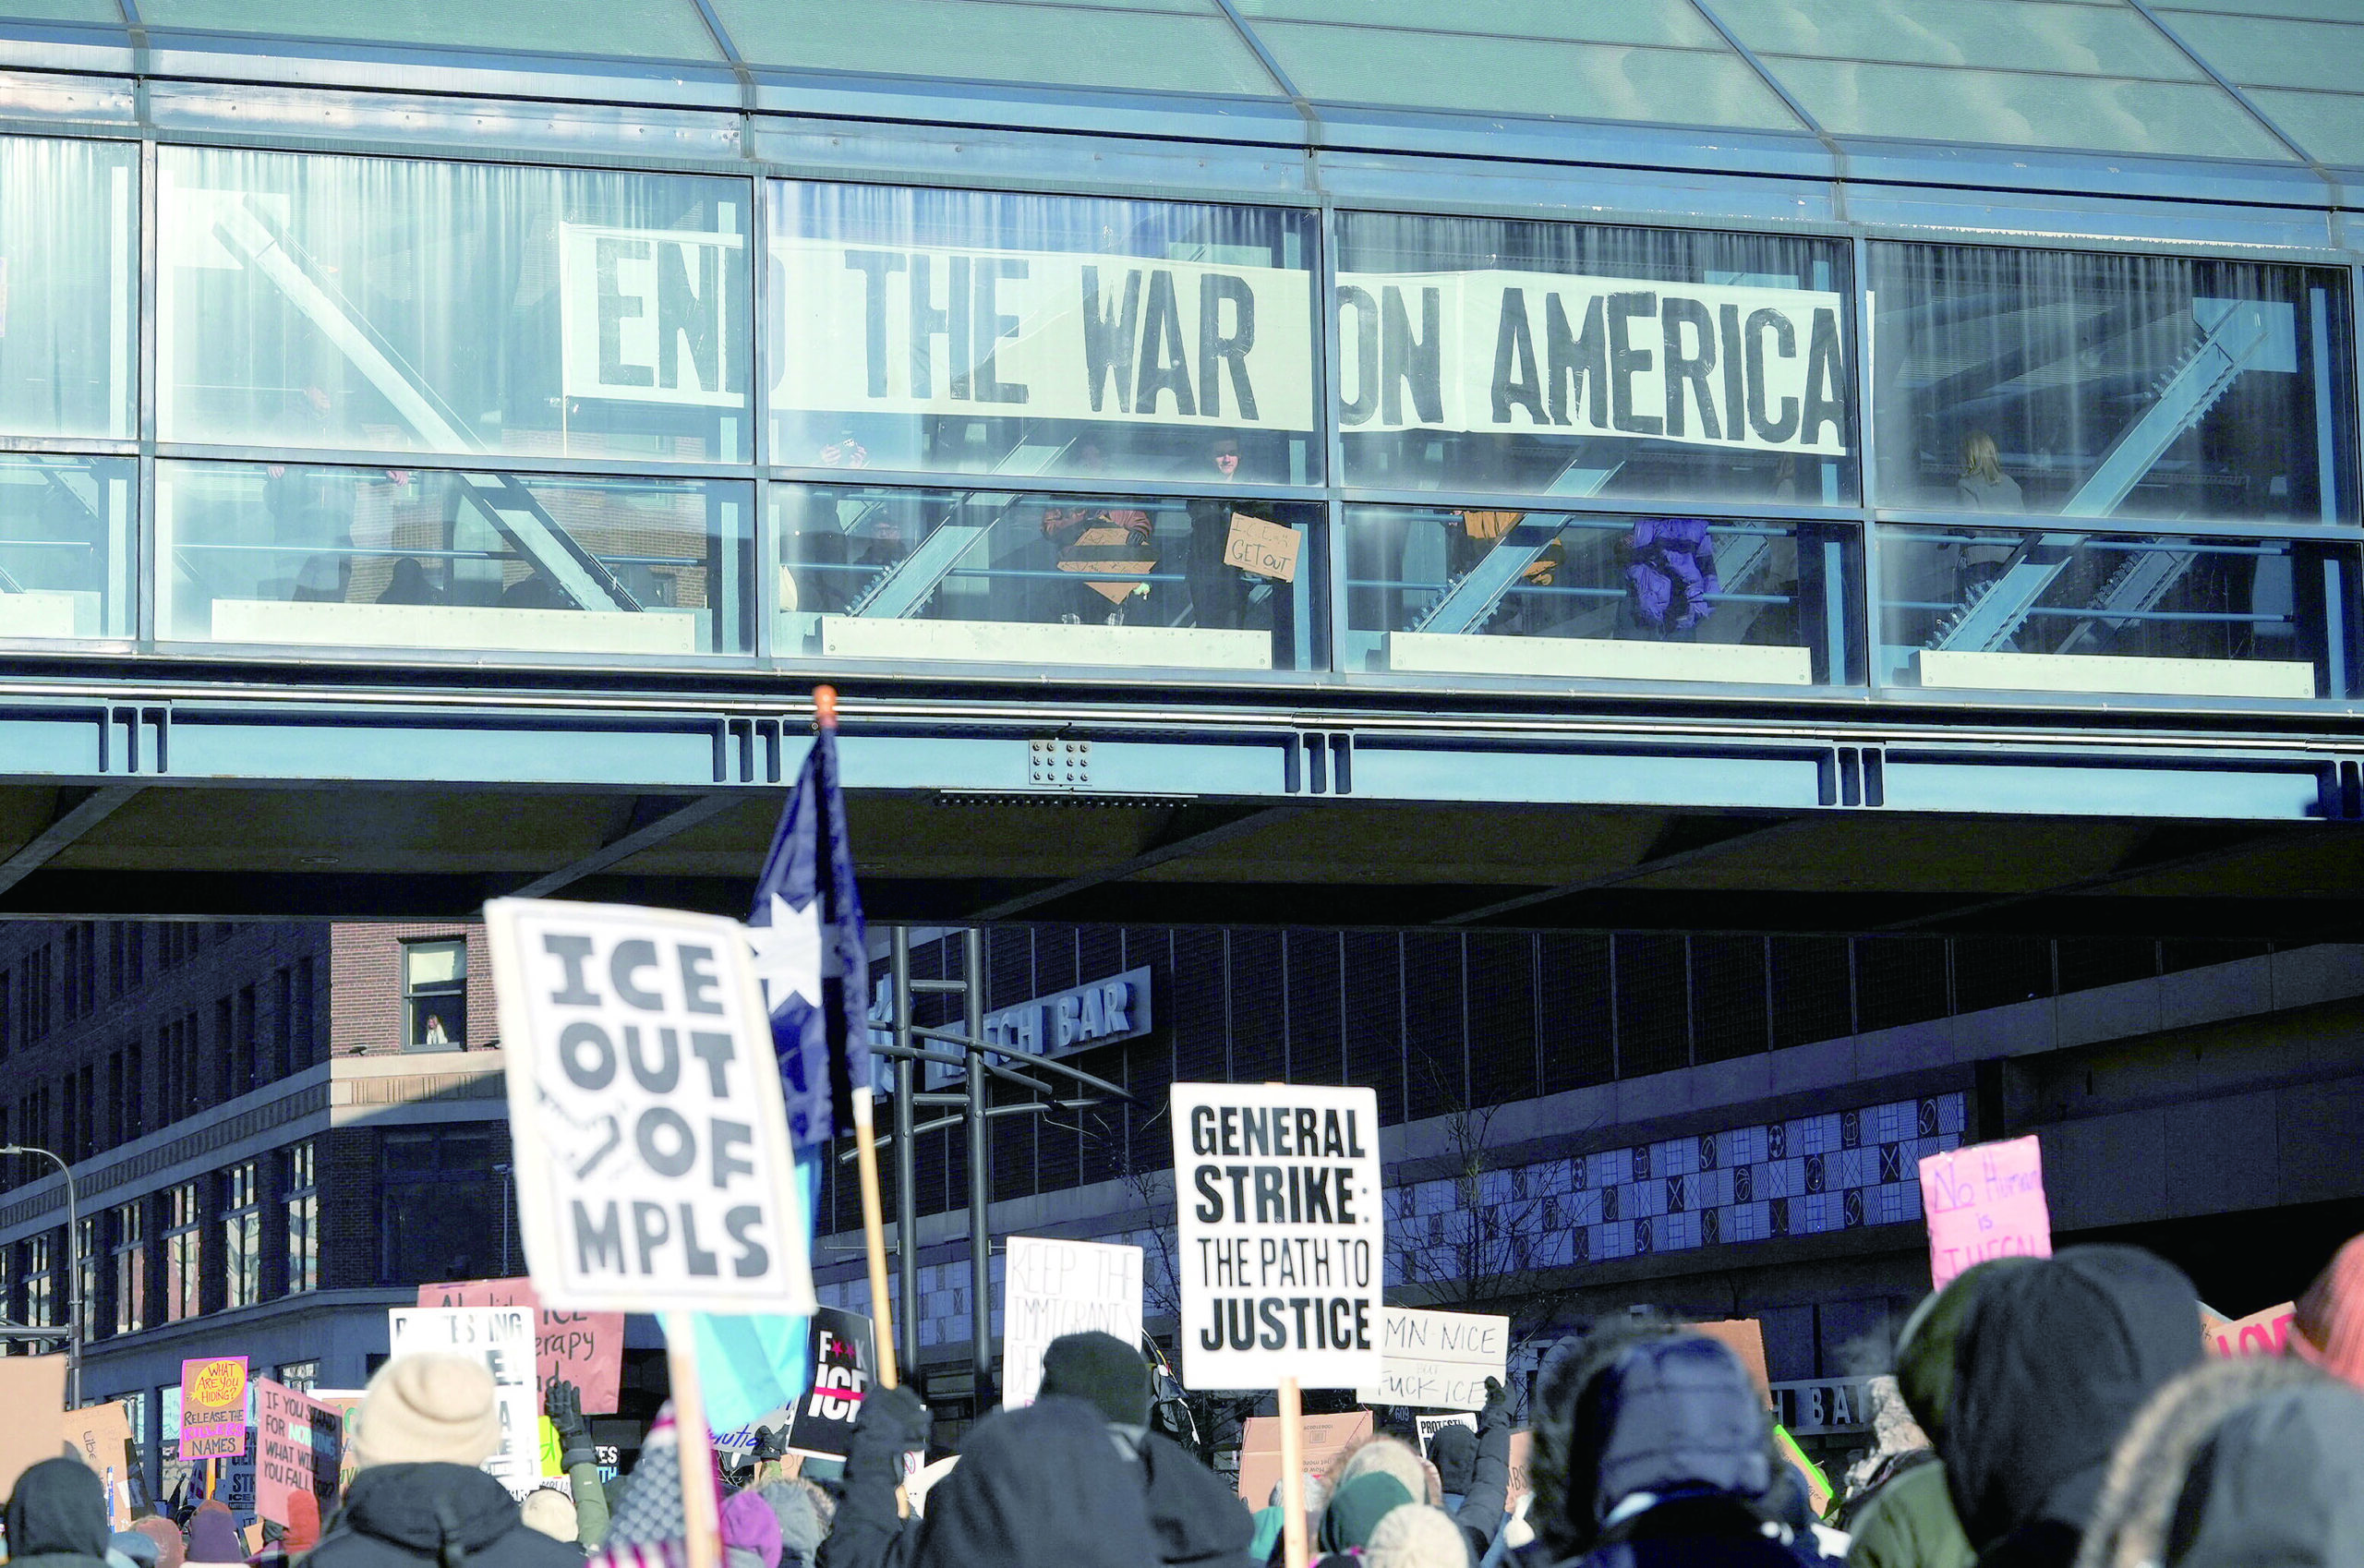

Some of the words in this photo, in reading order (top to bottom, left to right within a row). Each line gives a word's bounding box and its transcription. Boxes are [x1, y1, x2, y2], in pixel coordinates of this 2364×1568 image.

[597, 238, 785, 392] END
[845, 249, 1029, 404] THE
[1081, 265, 1260, 421] WAR
[1337, 285, 1444, 427] ON
[1491, 287, 1846, 445] AMERICA
[1232, 539, 1268, 566] GET
[1263, 554, 1291, 573] OUT
[541, 934, 724, 1015] ICE
[1057, 982, 1132, 1047] BAR
[560, 1022, 736, 1098] OUT
[636, 1106, 754, 1189] OF
[1191, 1105, 1366, 1159] GENERAL
[1195, 1164, 1371, 1224] STRIKE:
[1934, 1161, 1974, 1211] No
[572, 1200, 770, 1279] MPLS
[1976, 1212, 1993, 1231] is
[1011, 1244, 1076, 1295] KEEP
[1094, 1249, 1137, 1300] THE
[1198, 1238, 1249, 1287] THE
[1261, 1238, 1330, 1287] PATH
[1343, 1239, 1369, 1287] TO
[1201, 1297, 1371, 1351] JUSTICE
[1385, 1316, 1428, 1348] MN
[1441, 1322, 1495, 1353] NICE
[199, 1377, 218, 1390] ARE
[219, 1377, 238, 1392] YOU
[208, 1364, 235, 1377] WHAT
[201, 1388, 237, 1403] HIDING?
[265, 1391, 279, 1409] IF
[283, 1396, 303, 1418] YOU
[306, 1404, 336, 1431] STAND
[1446, 1381, 1487, 1404] ICE
[185, 1410, 228, 1427] RELEASE
[230, 1409, 244, 1422] THE
[185, 1422, 244, 1441] KILLERS
[1395, 1407, 1410, 1422] 609
[192, 1438, 236, 1456] NAMES
[266, 1415, 285, 1437] FOR
[288, 1422, 335, 1455] NOTHING
[263, 1462, 283, 1483] YOU
[284, 1468, 310, 1491] FALL
[265, 1440, 294, 1464] WHAT
[297, 1450, 320, 1476] WILL
